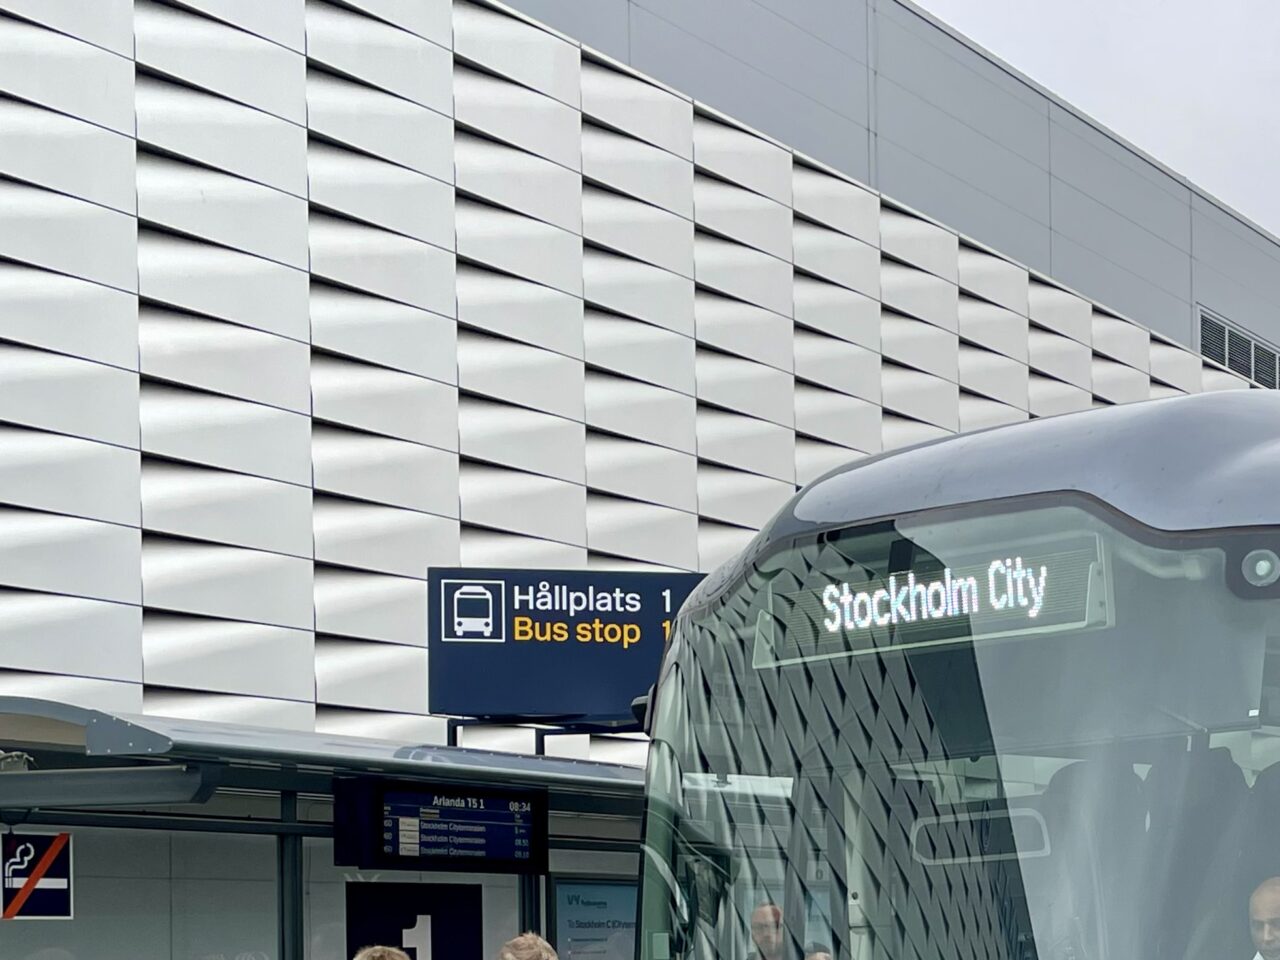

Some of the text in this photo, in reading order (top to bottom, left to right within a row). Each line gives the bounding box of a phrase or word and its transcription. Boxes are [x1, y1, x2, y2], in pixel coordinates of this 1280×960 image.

[513, 581, 672, 617] Hållplats 1
[822, 556, 1048, 634] Stockholm City
[513, 616, 569, 642] Bus
[575, 619, 642, 648] stop
[432, 795, 465, 808] Arlanda
